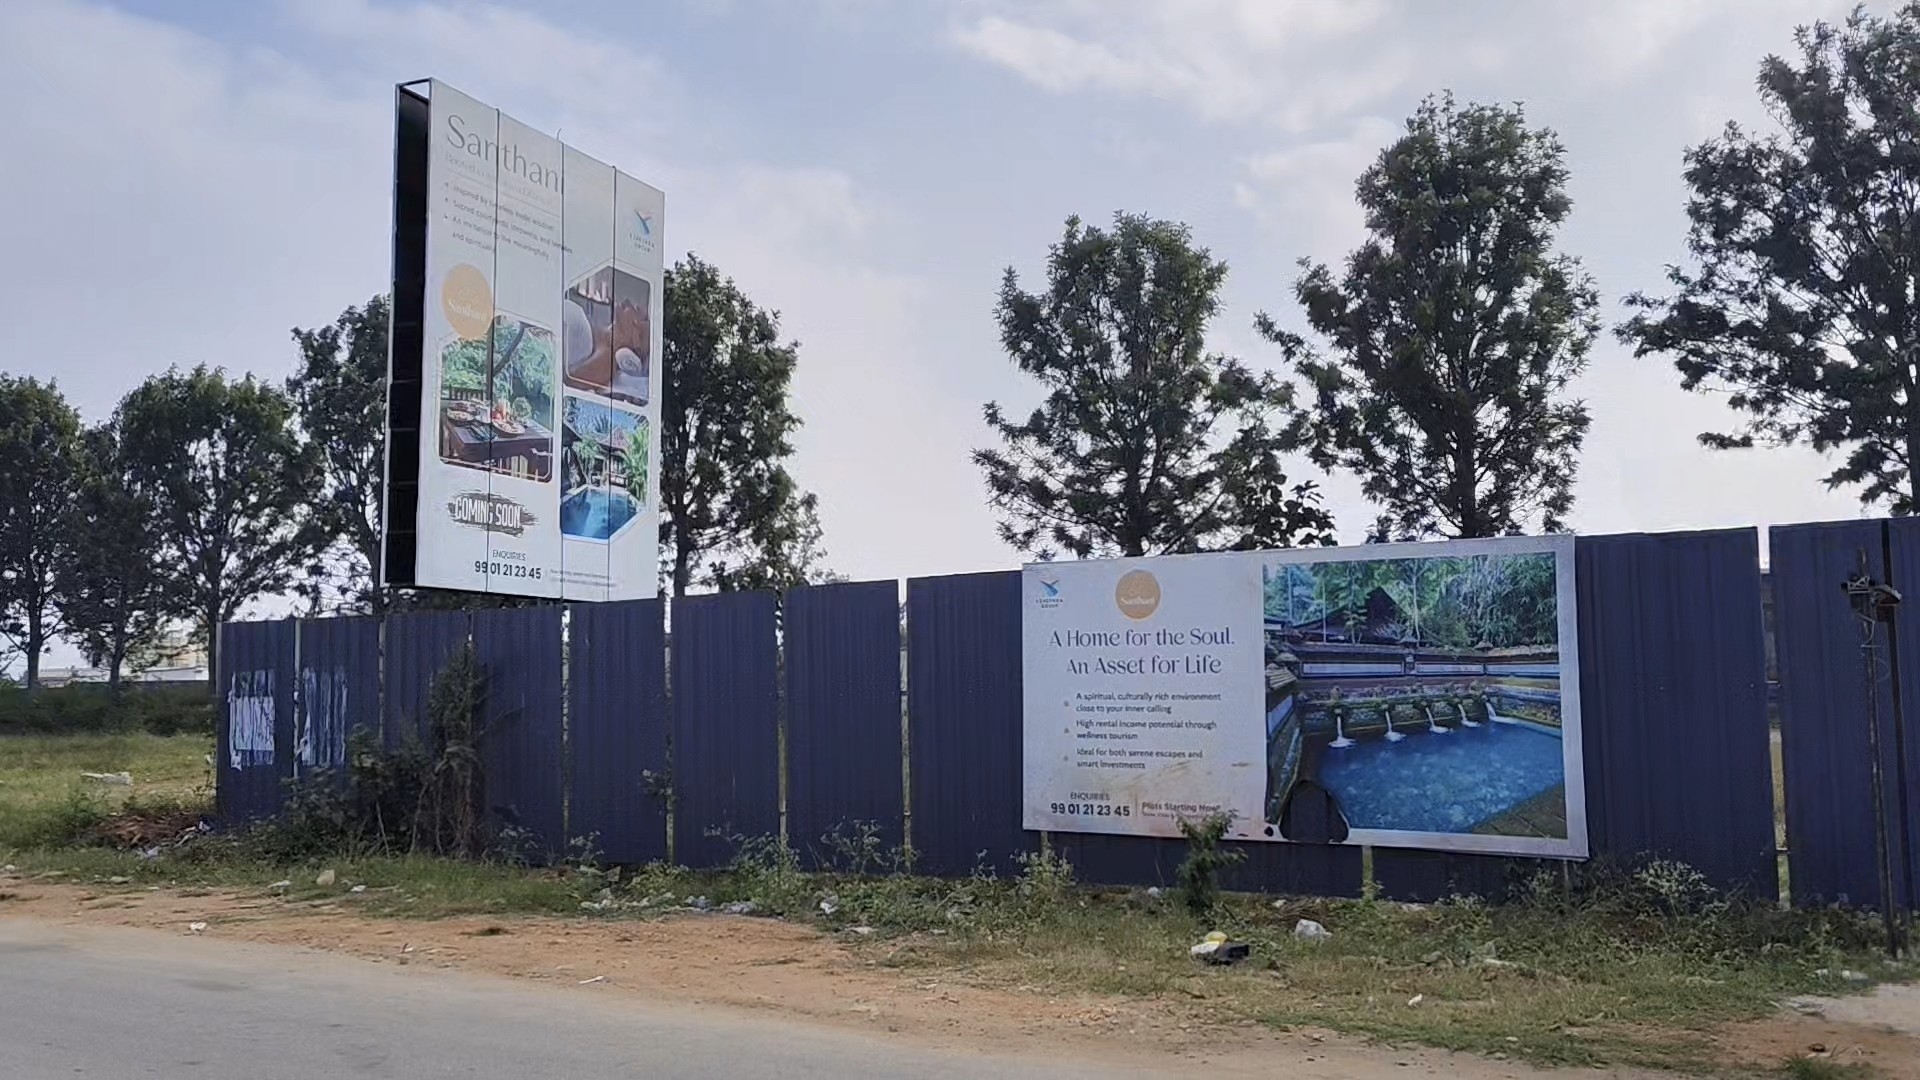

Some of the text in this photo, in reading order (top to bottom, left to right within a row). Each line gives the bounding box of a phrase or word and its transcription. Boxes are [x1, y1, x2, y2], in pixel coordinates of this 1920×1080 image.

[454, 496, 521, 529] COMING SOON
[474, 561, 488, 573] 99
[490, 562, 500, 575] 01
[503, 564, 513, 576] 21
[515, 565, 526, 577] 23
[529, 567, 541, 579] 45
[1050, 627, 1235, 647] A Home for the Soul.
[1067, 654, 1222, 675] An Asset for Life
[1117, 692, 1153, 702] culturally
[1155, 692, 1169, 700] rich
[1171, 692, 1221, 700] environment
[1076, 704, 1095, 712] close
[1106, 705, 1123, 714] your
[1146, 704, 1172, 714] calling
[1076, 719, 1217, 730] High rental income potential through
[1109, 732, 1138, 740] tourism
[1077, 748, 1094, 756] Ideal
[1096, 747, 1107, 756] for
[1109, 748, 1127, 757] both
[1155, 750, 1186, 759] escapes
[1188, 749, 1203, 758] and
[1077, 760, 1146, 769] smart investments
[1051, 802, 1066, 814] 99
[1068, 803, 1080, 815] 01
[1083, 803, 1094, 815] 21
[1097, 804, 1111, 816] 23
[1114, 805, 1130, 816] 45
[1164, 802, 1197, 812] Starting
